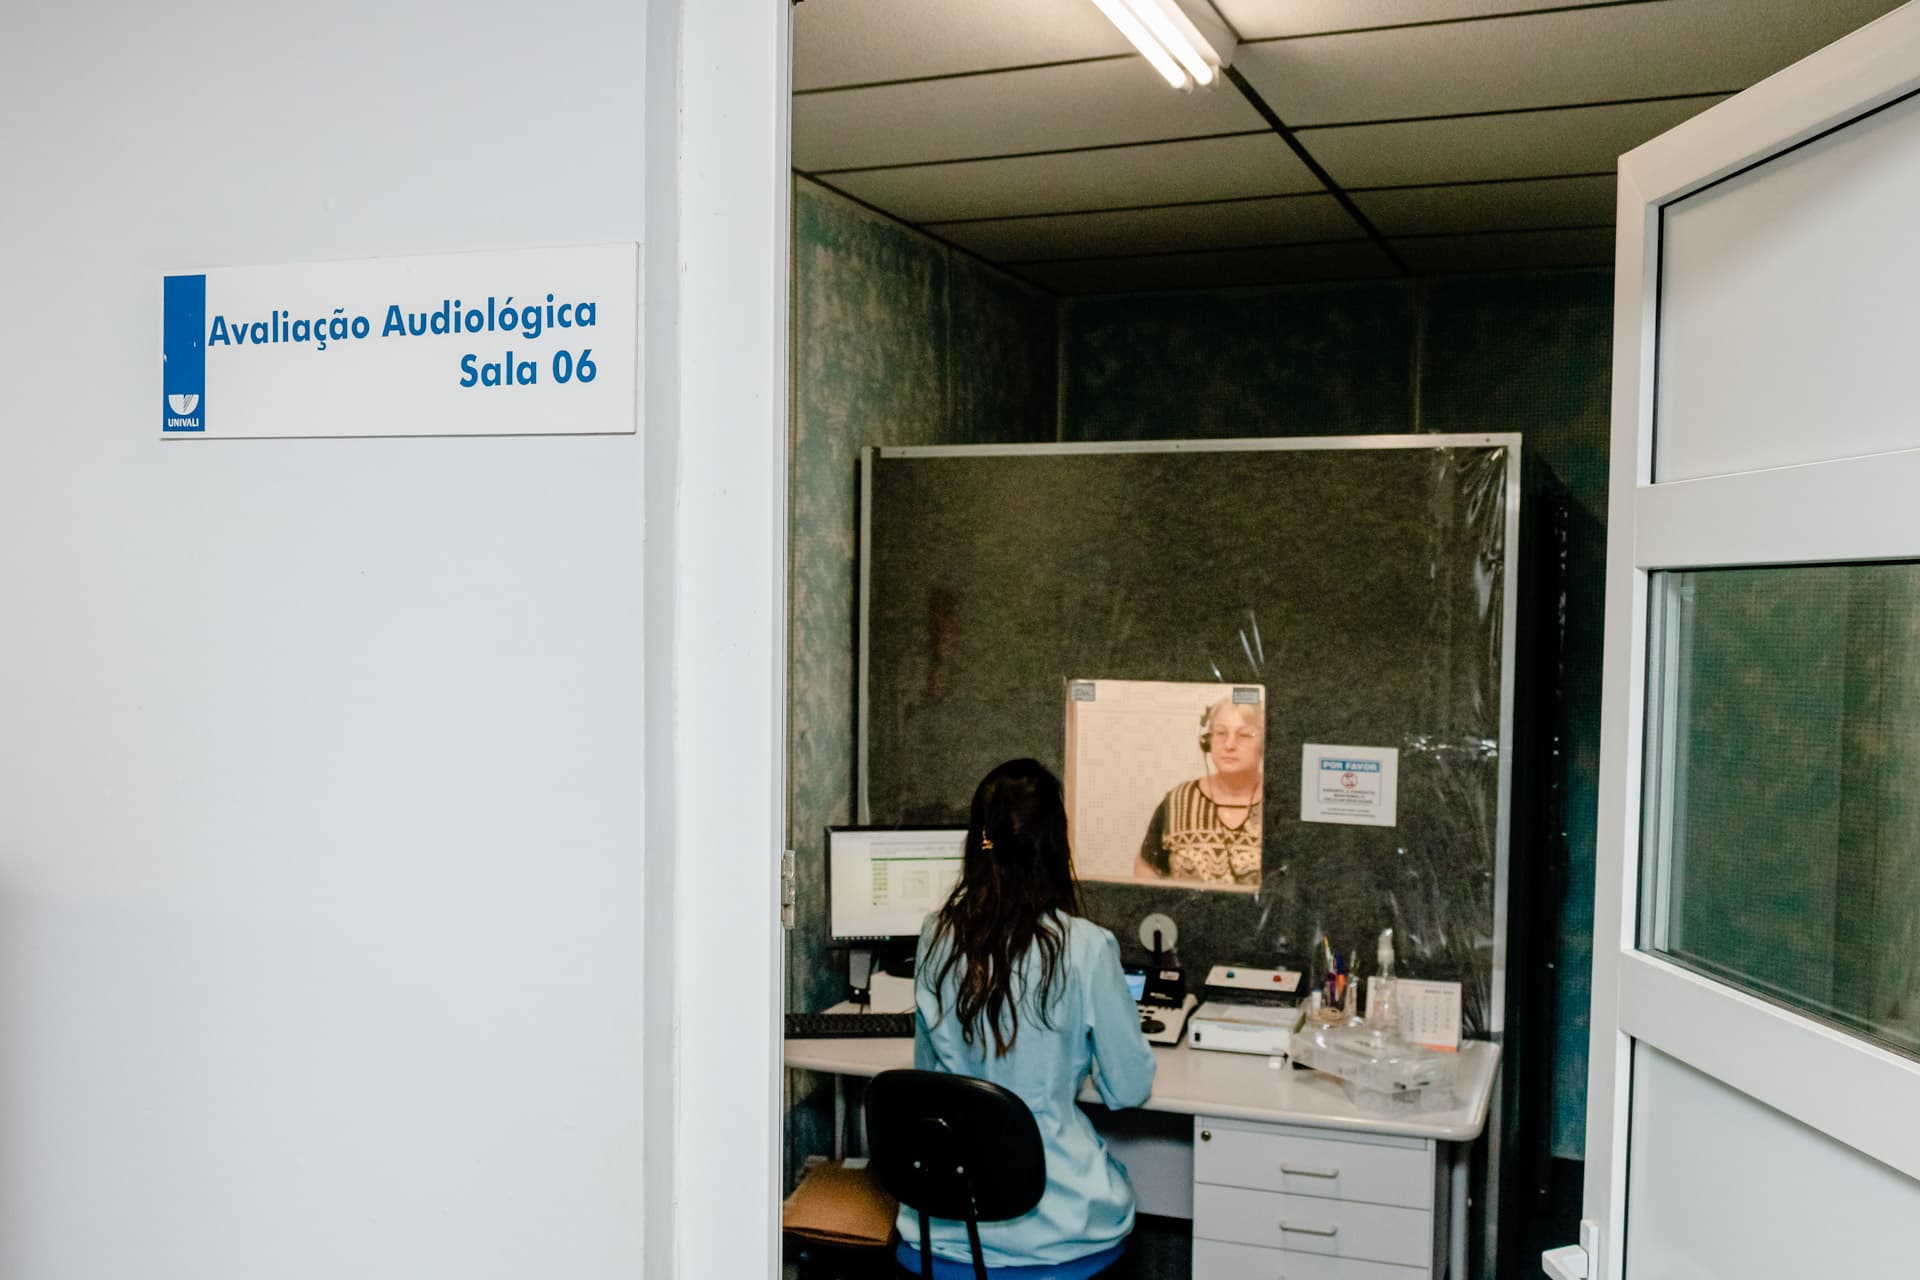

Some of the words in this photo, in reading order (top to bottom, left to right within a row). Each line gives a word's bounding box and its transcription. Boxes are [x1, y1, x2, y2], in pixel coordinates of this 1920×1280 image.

[207, 308, 370, 351] Avaliação
[382, 293, 597, 340] Audiológica
[460, 349, 537, 387] Sala
[552, 349, 597, 384] 06
[168, 418, 199, 428] UNIVALI
